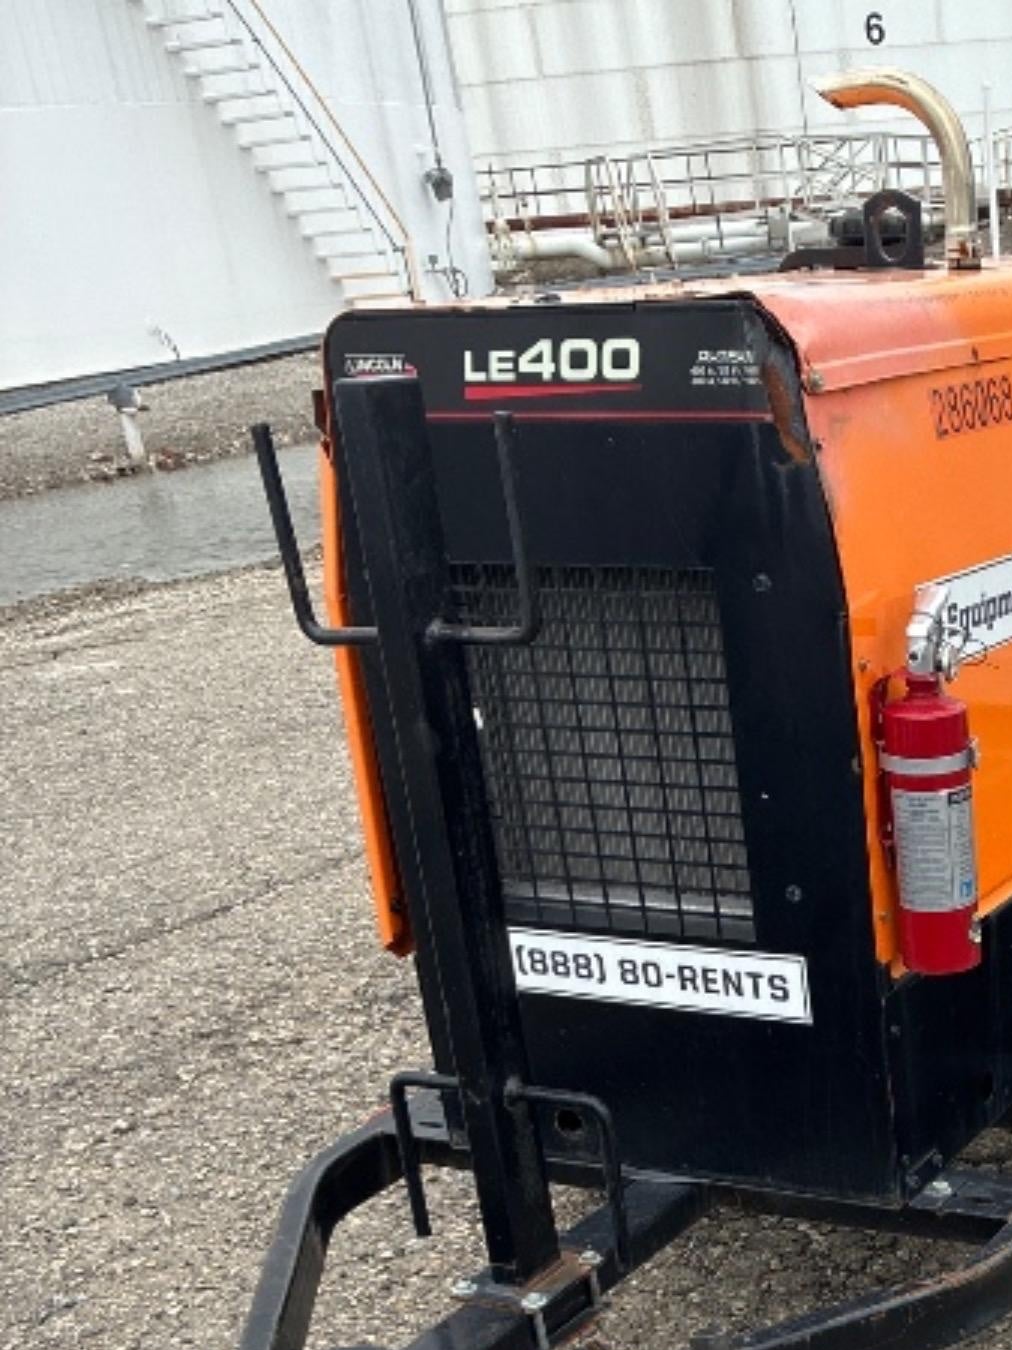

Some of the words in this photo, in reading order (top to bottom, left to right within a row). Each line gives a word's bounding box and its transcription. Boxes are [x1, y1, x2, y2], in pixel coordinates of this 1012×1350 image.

[866, 11, 886, 46] 6
[464, 338, 640, 382] LE400
[516, 944, 607, 984] (888)
[617, 959, 790, 1002] 80-RENTS
